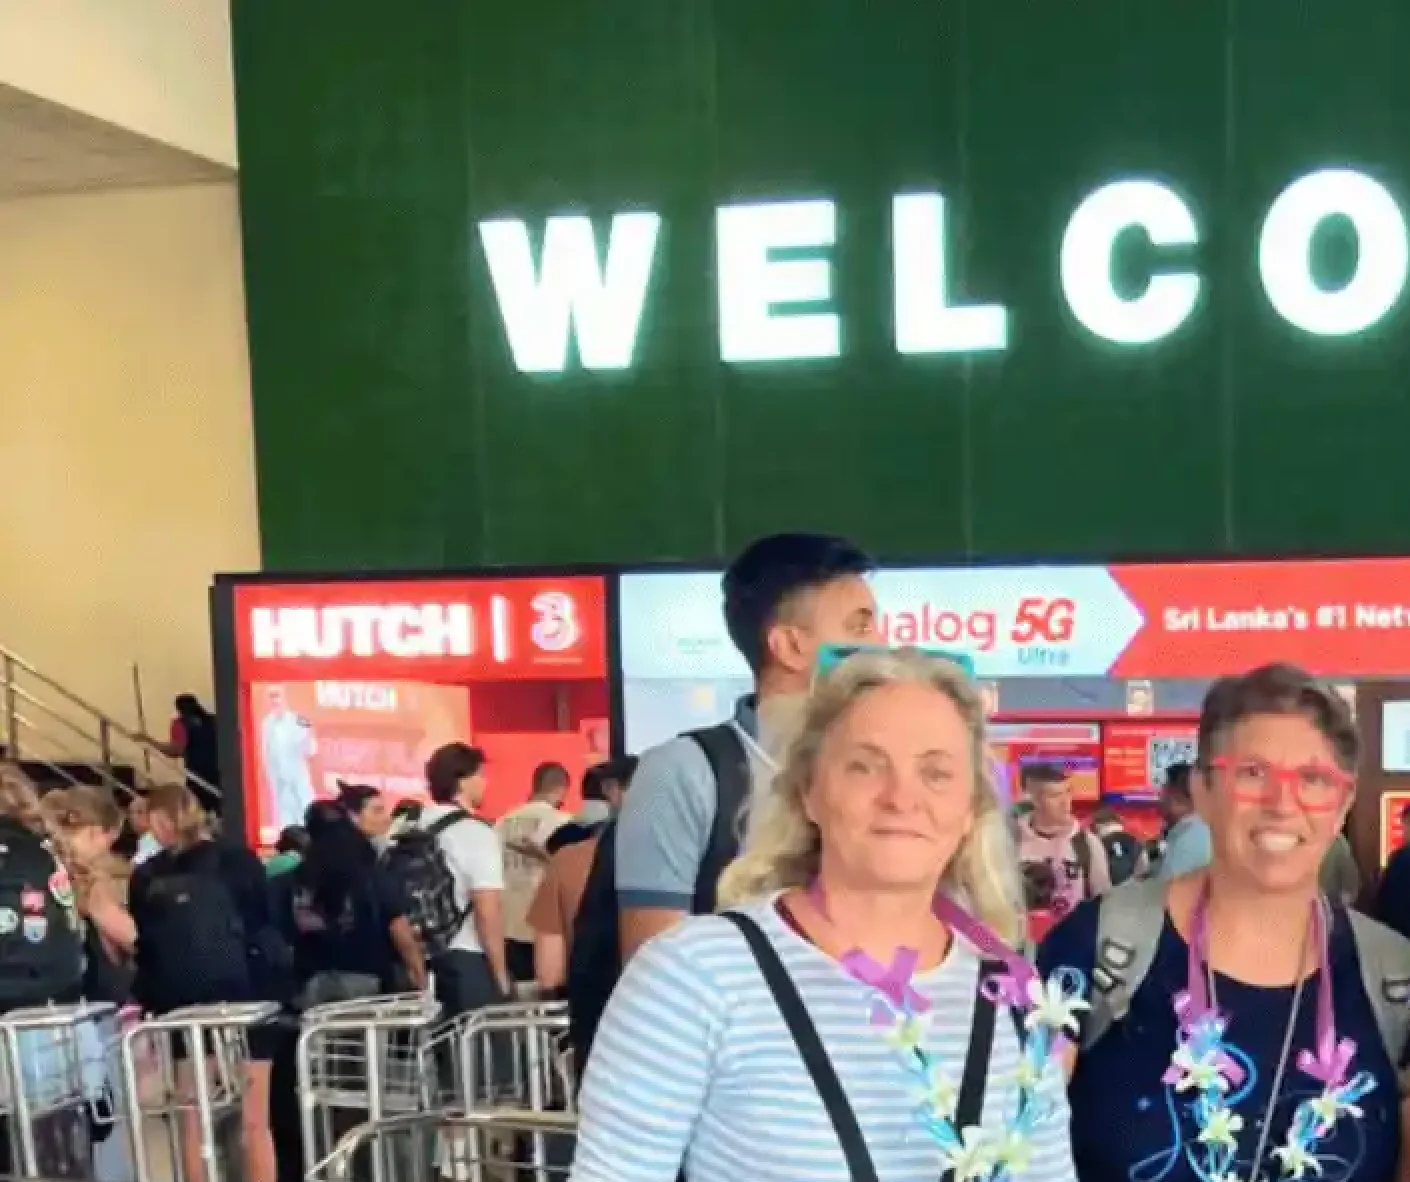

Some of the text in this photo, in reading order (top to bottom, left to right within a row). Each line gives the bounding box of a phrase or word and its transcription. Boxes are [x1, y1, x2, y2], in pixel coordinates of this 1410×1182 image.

[251, 591, 582, 659] HUTCH 3
[1009, 597, 1075, 644] 5G
[1162, 605, 1201, 631] Sri
[1205, 604, 1309, 631] Lanka's
